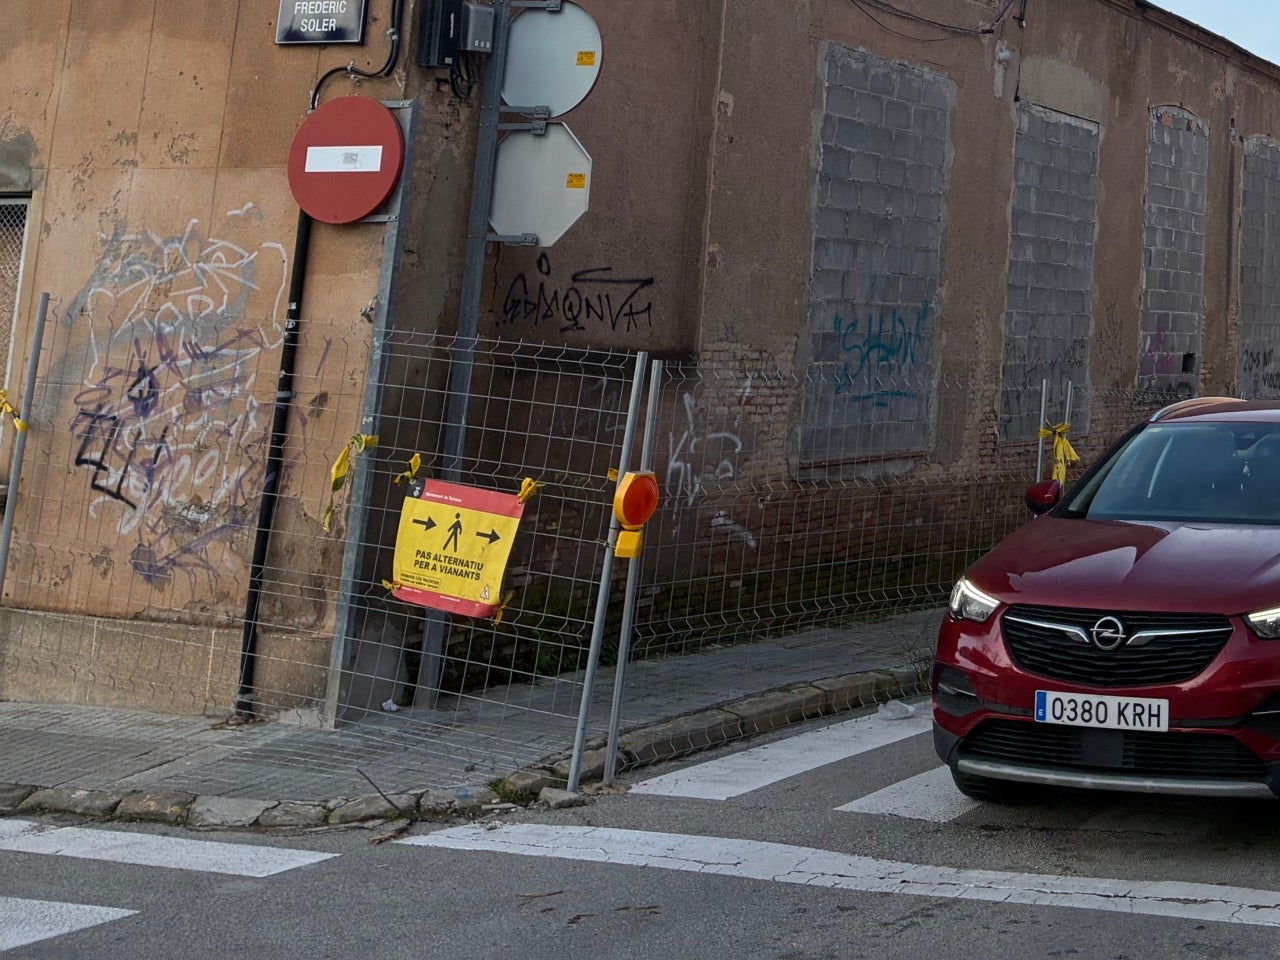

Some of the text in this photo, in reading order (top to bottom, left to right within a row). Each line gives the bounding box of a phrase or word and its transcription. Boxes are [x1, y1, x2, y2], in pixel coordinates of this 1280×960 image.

[294, 0, 347, 14] FREDERIC
[300, 18, 336, 32] SOLER
[414, 560, 430, 571] PER
[431, 563, 437, 572] A
[439, 565, 481, 581] VIANANTS
[415, 549, 484, 571] PAS ALTERNATIU
[1052, 697, 1161, 728] 0380 KRH
